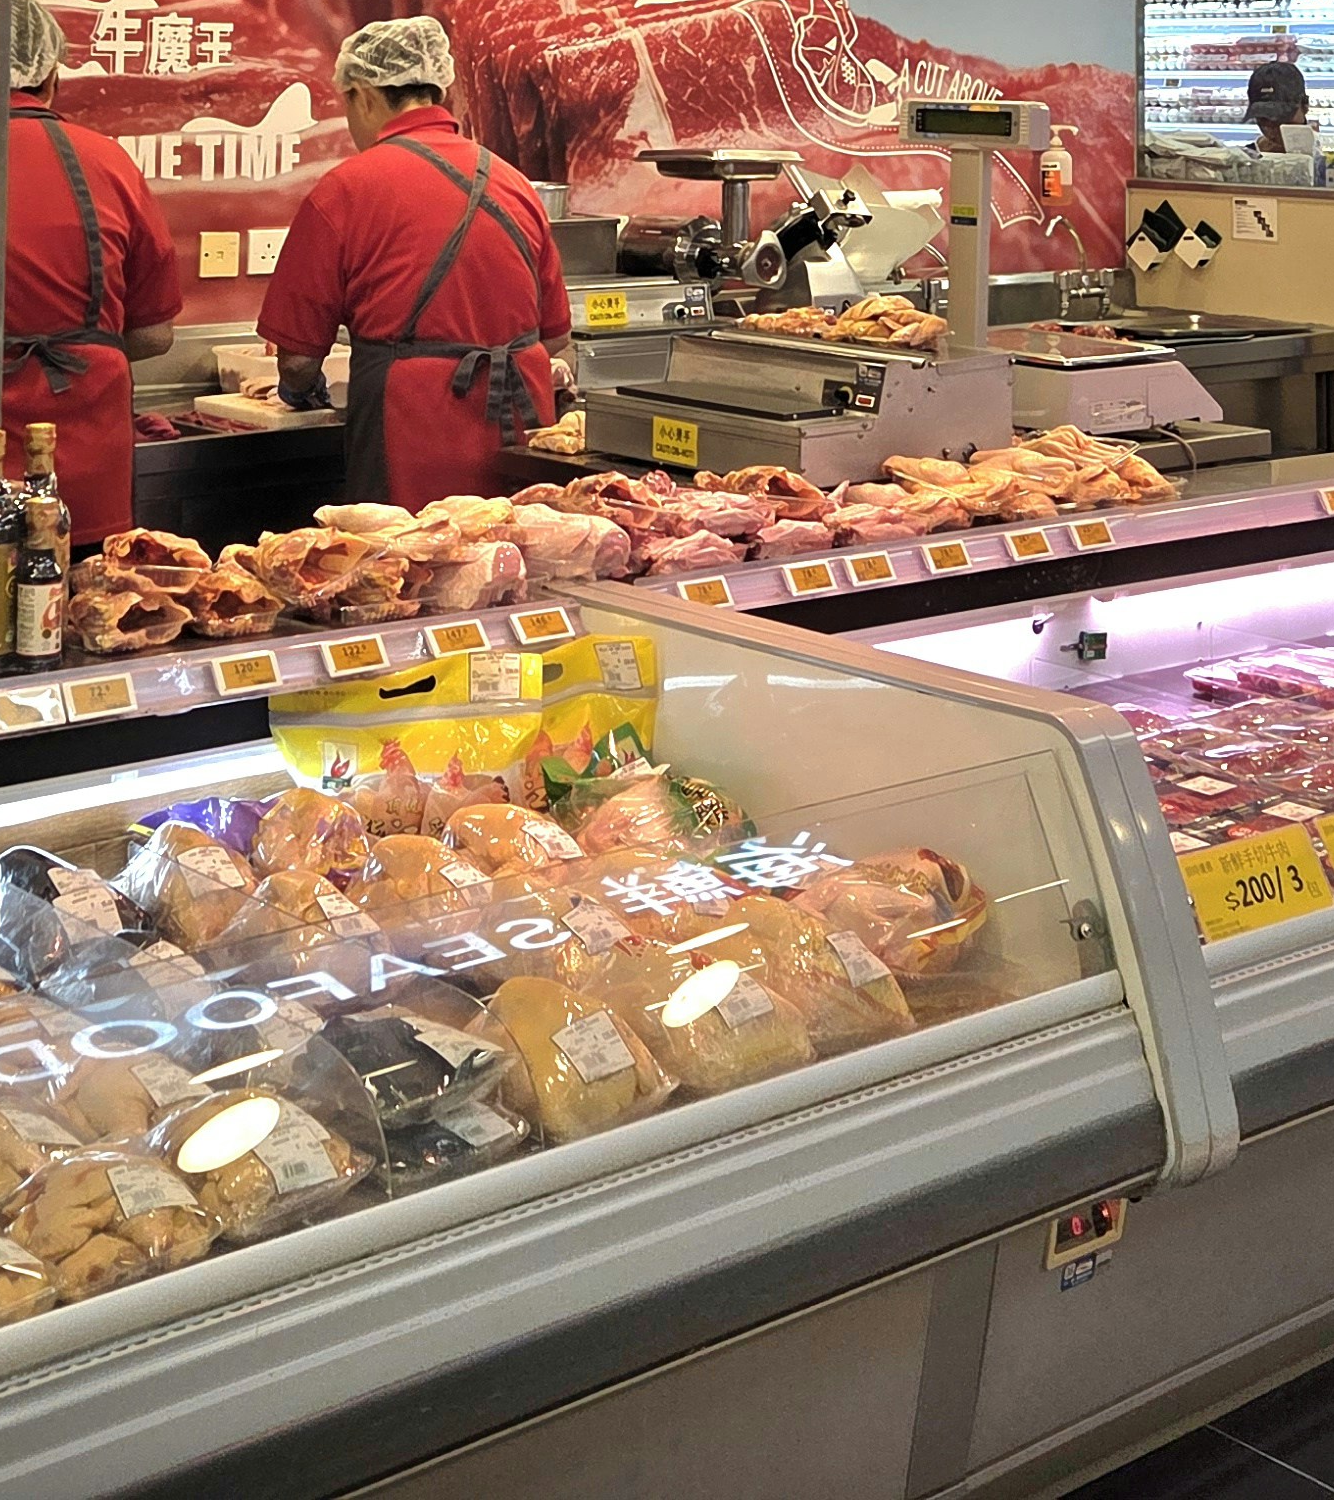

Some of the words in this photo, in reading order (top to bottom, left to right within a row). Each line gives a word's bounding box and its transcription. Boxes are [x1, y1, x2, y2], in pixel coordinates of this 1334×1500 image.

[90, 7, 235, 76] 牛魔王
[913, 60, 950, 98] CUT
[195, 134, 301, 182] TIME
